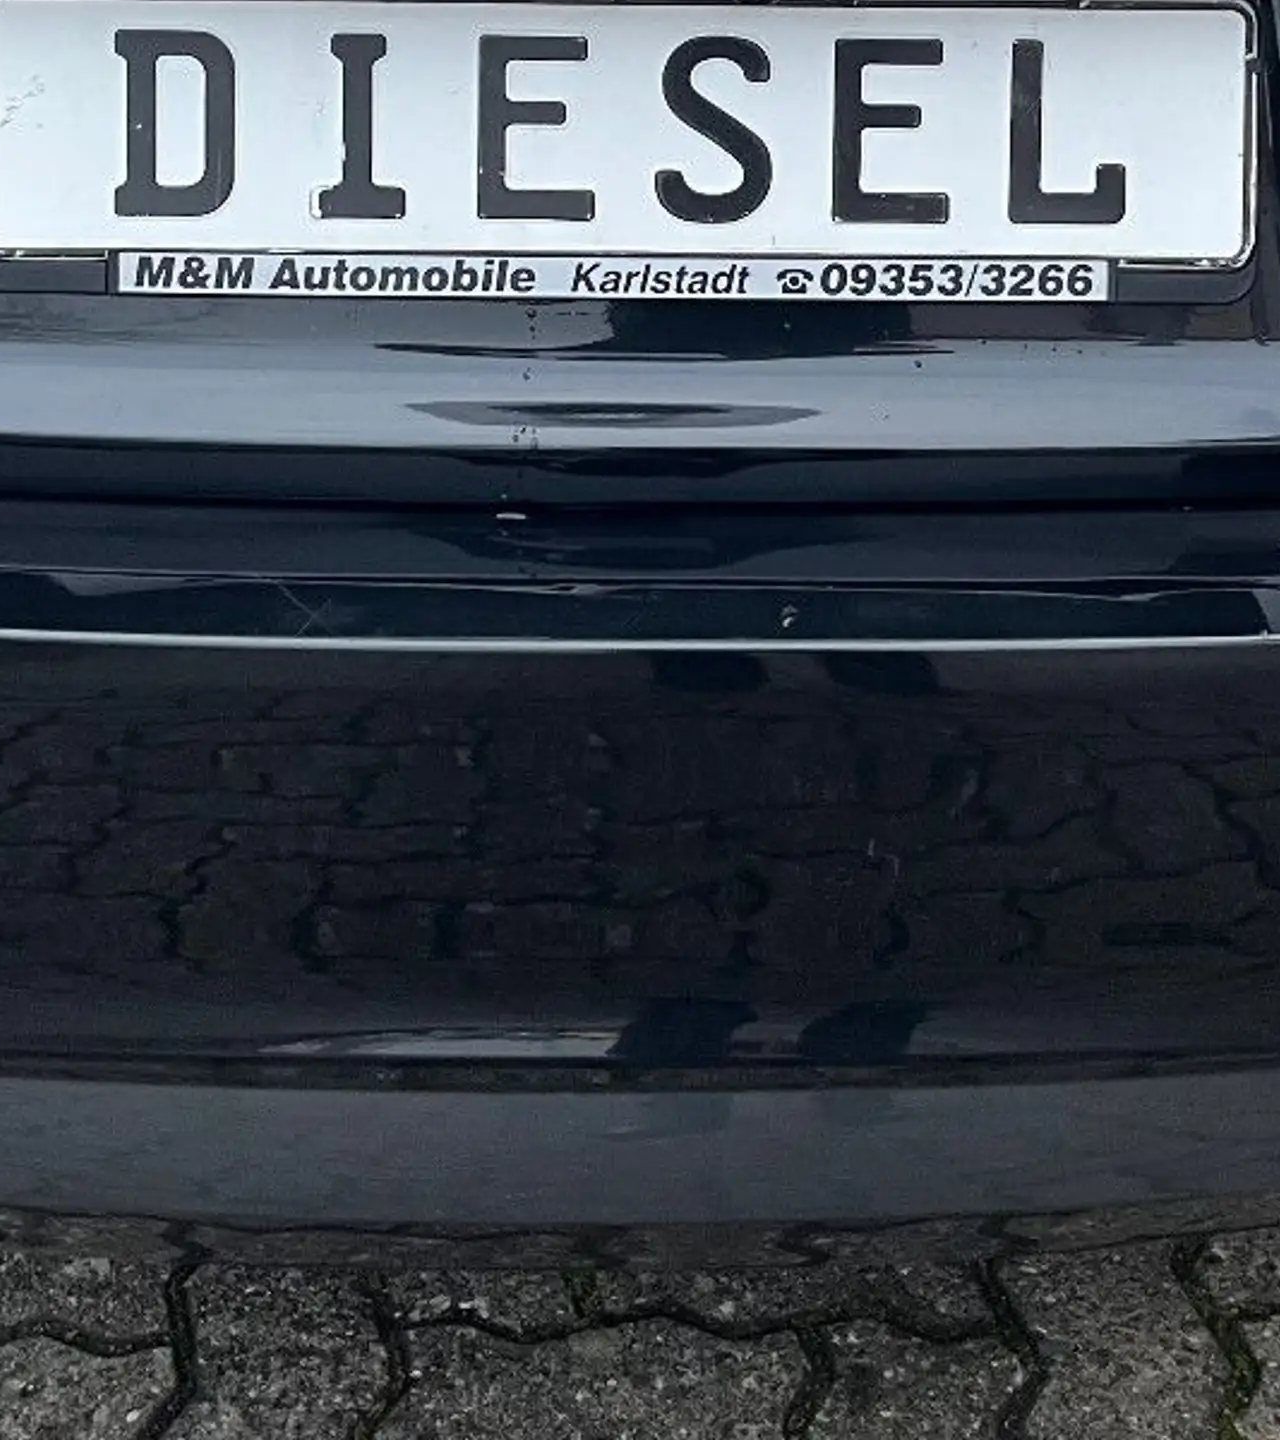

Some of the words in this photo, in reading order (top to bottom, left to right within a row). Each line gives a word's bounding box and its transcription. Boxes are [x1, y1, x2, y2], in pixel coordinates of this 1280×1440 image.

[113, 27, 1127, 225] DIESEL
[133, 257, 254, 291] M&M
[269, 258, 537, 294] Automobile
[570, 263, 751, 296] Karlstadt
[819, 262, 1095, 298] 09353/3266
